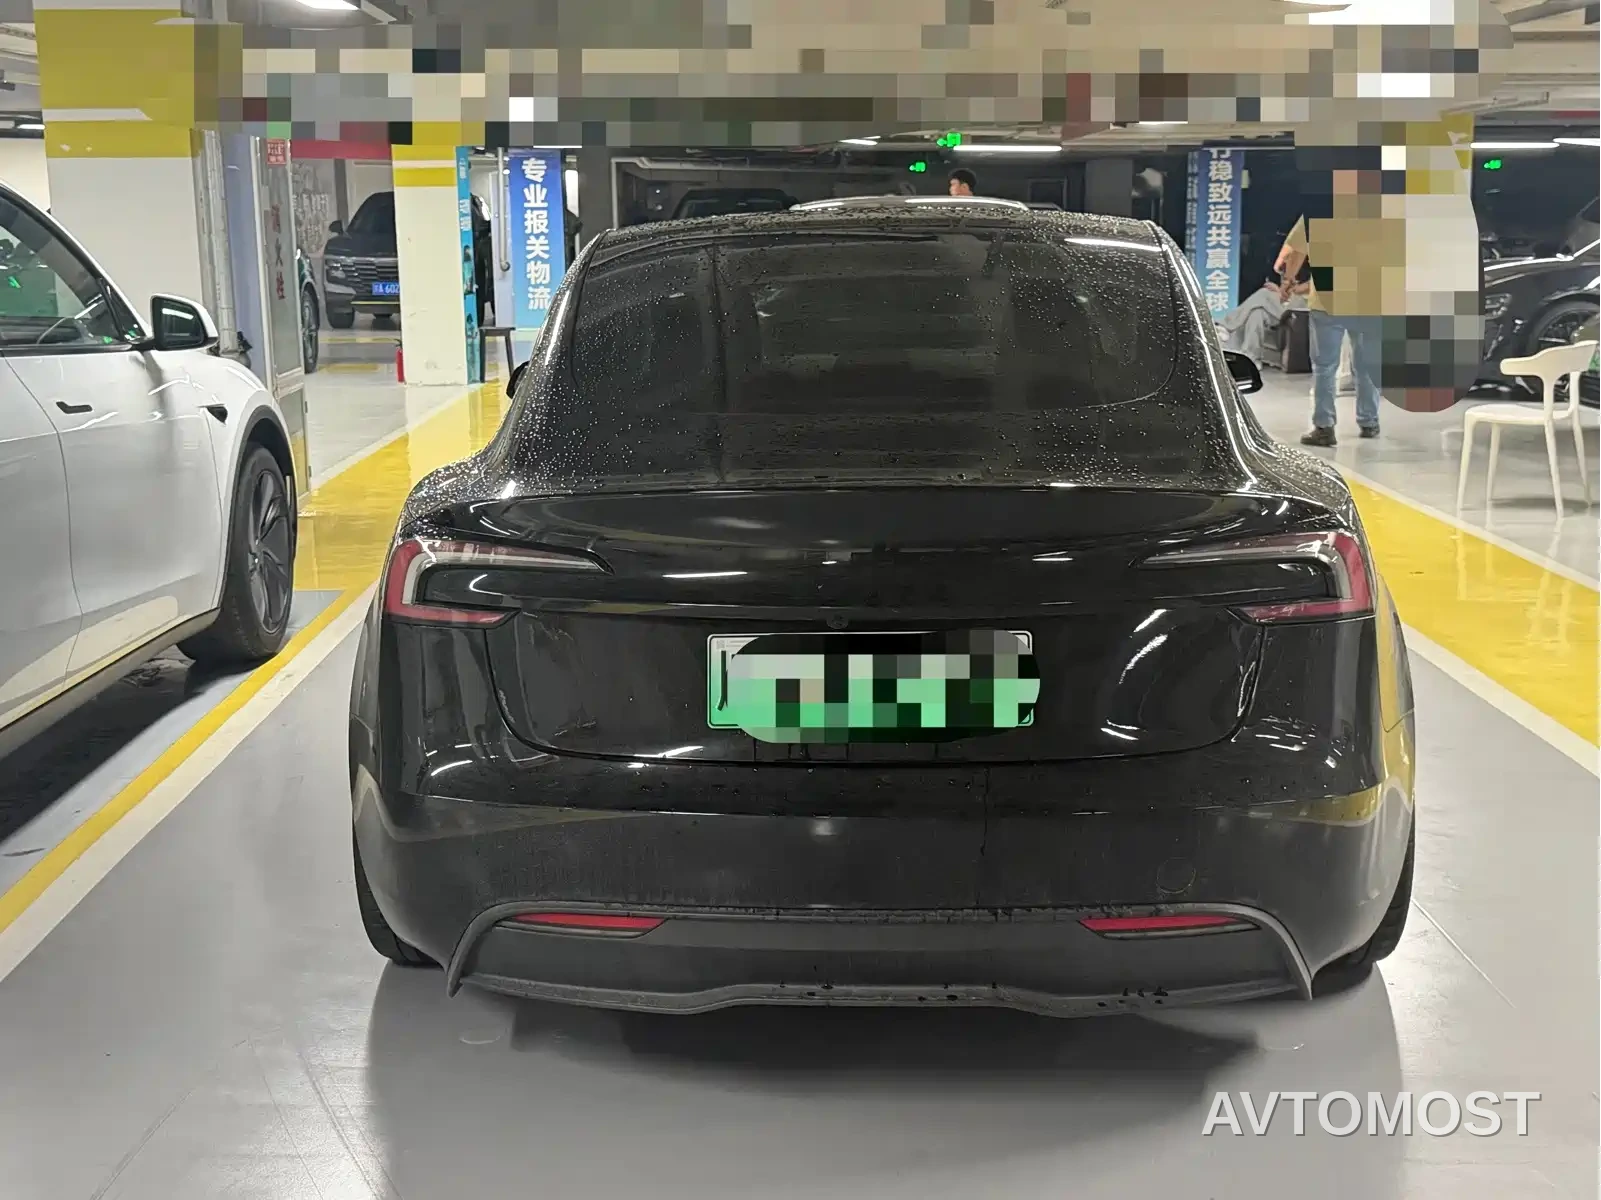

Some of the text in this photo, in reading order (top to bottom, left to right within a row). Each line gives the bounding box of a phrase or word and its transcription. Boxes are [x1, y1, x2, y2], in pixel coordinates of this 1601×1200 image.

[521, 157, 552, 311] 专业报关物流
